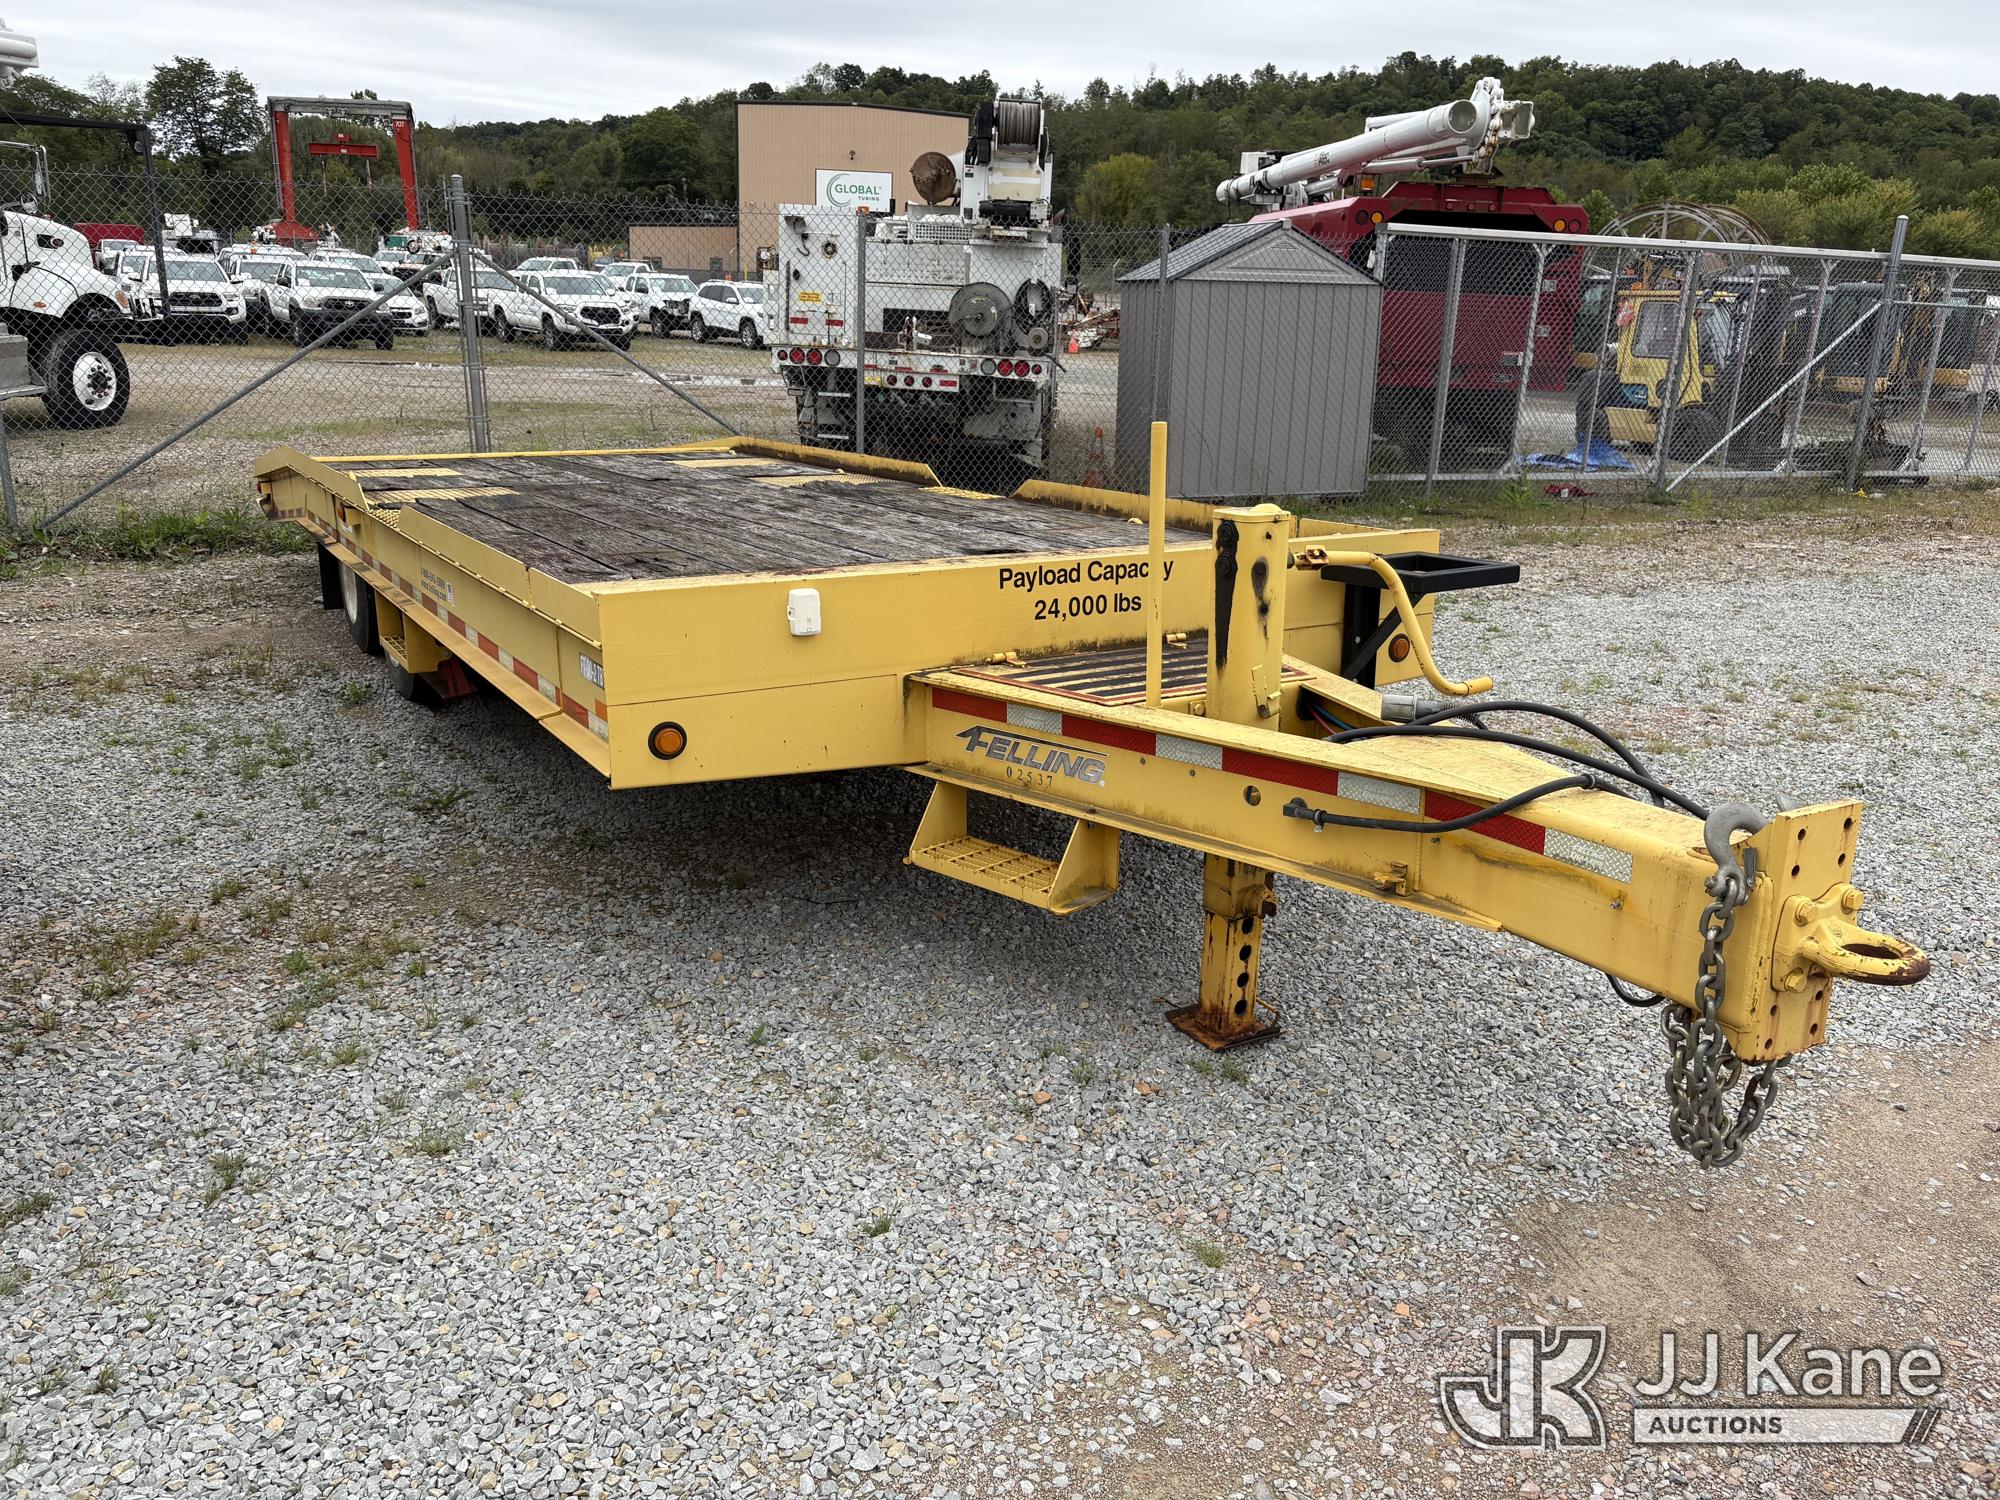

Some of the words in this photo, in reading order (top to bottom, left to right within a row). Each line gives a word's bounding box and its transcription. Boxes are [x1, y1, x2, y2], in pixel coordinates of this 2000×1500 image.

[834, 183, 880, 196] GLOBAL
[999, 562, 1081, 593] Payload
[1087, 560, 1174, 585] Capacy
[1034, 594, 1108, 622] 24,000
[1113, 592, 1142, 613] lbs
[956, 725, 1109, 784] FELLING
[1006, 766, 1053, 787] 02537
